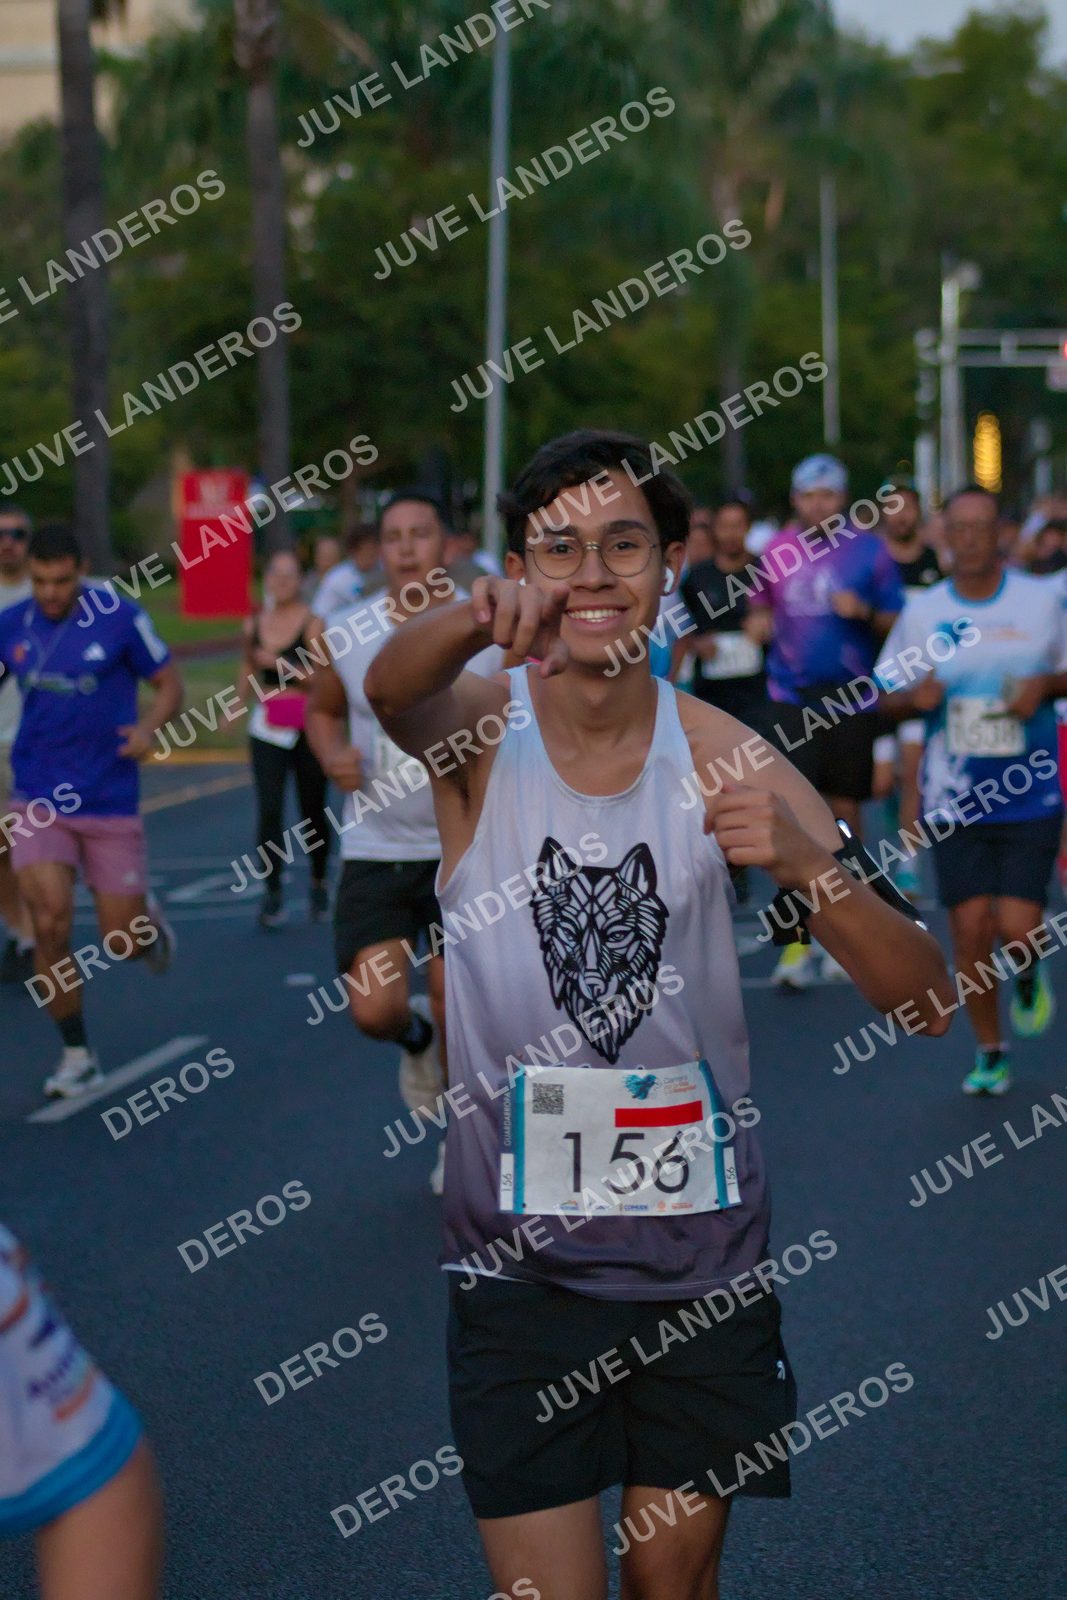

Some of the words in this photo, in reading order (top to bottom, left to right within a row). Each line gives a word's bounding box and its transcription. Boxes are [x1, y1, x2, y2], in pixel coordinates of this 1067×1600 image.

[563, 1130, 690, 1194] 156
[501, 1172, 512, 1193] 156
[727, 1166, 736, 1186] 156
